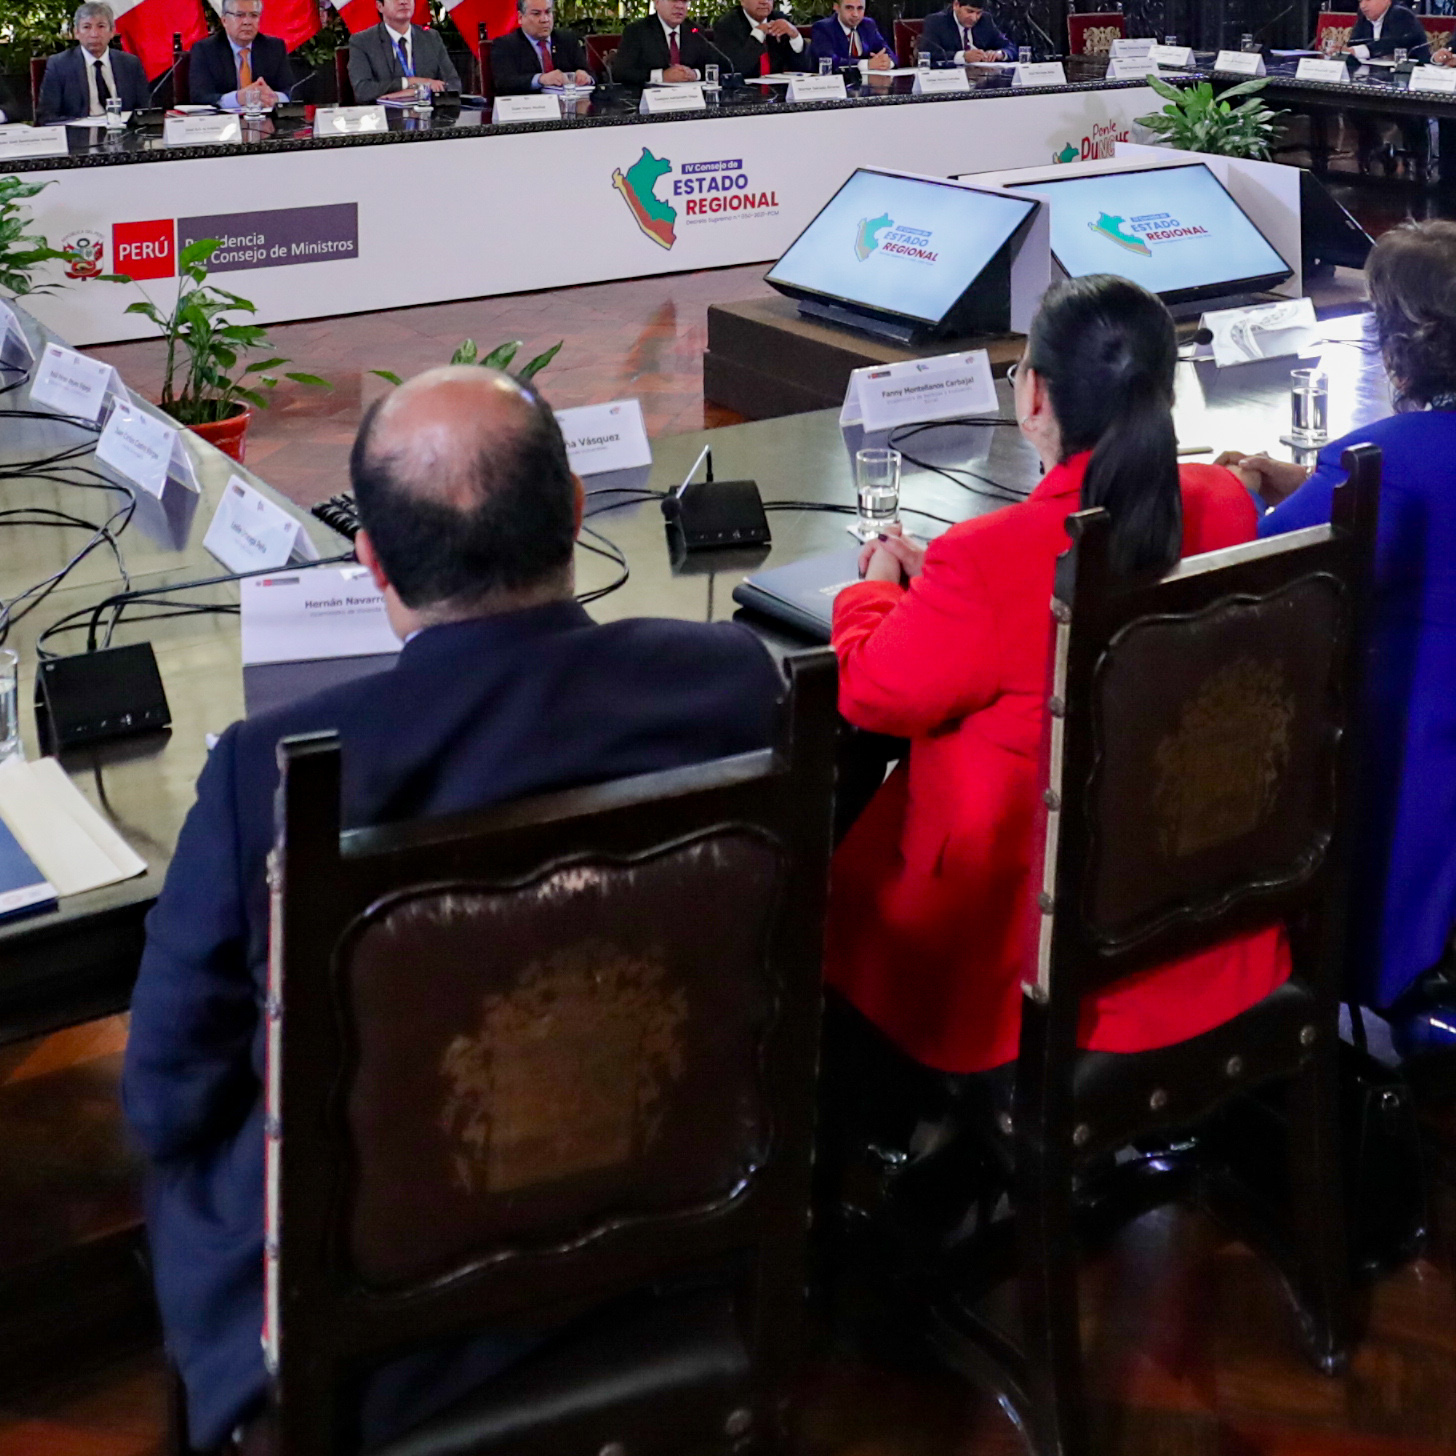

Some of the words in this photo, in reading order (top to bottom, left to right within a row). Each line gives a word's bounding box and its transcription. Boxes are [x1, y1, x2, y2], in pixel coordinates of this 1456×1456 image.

[685, 164, 694, 173] IV
[695, 161, 727, 172] Consejo
[728, 160, 738, 169] de
[673, 174, 748, 196] ESTADO
[686, 192, 779, 216] REGIONAL
[1131, 219, 1180, 233] ESTADO
[1145, 225, 1208, 241] REGIONAL
[883, 231, 929, 247] ESTADO
[119, 236, 169, 262] PERÚ
[211, 247, 266, 264] Consejo
[270, 245, 287, 260] de
[291, 239, 354, 257] Ministros
[882, 242, 939, 262] REGIONAL
[882, 389, 902, 398] Fanny
[945, 376, 975, 388] Carbajal
[578, 433, 621, 446] Vásquez
[305, 598, 343, 609] Hernán
